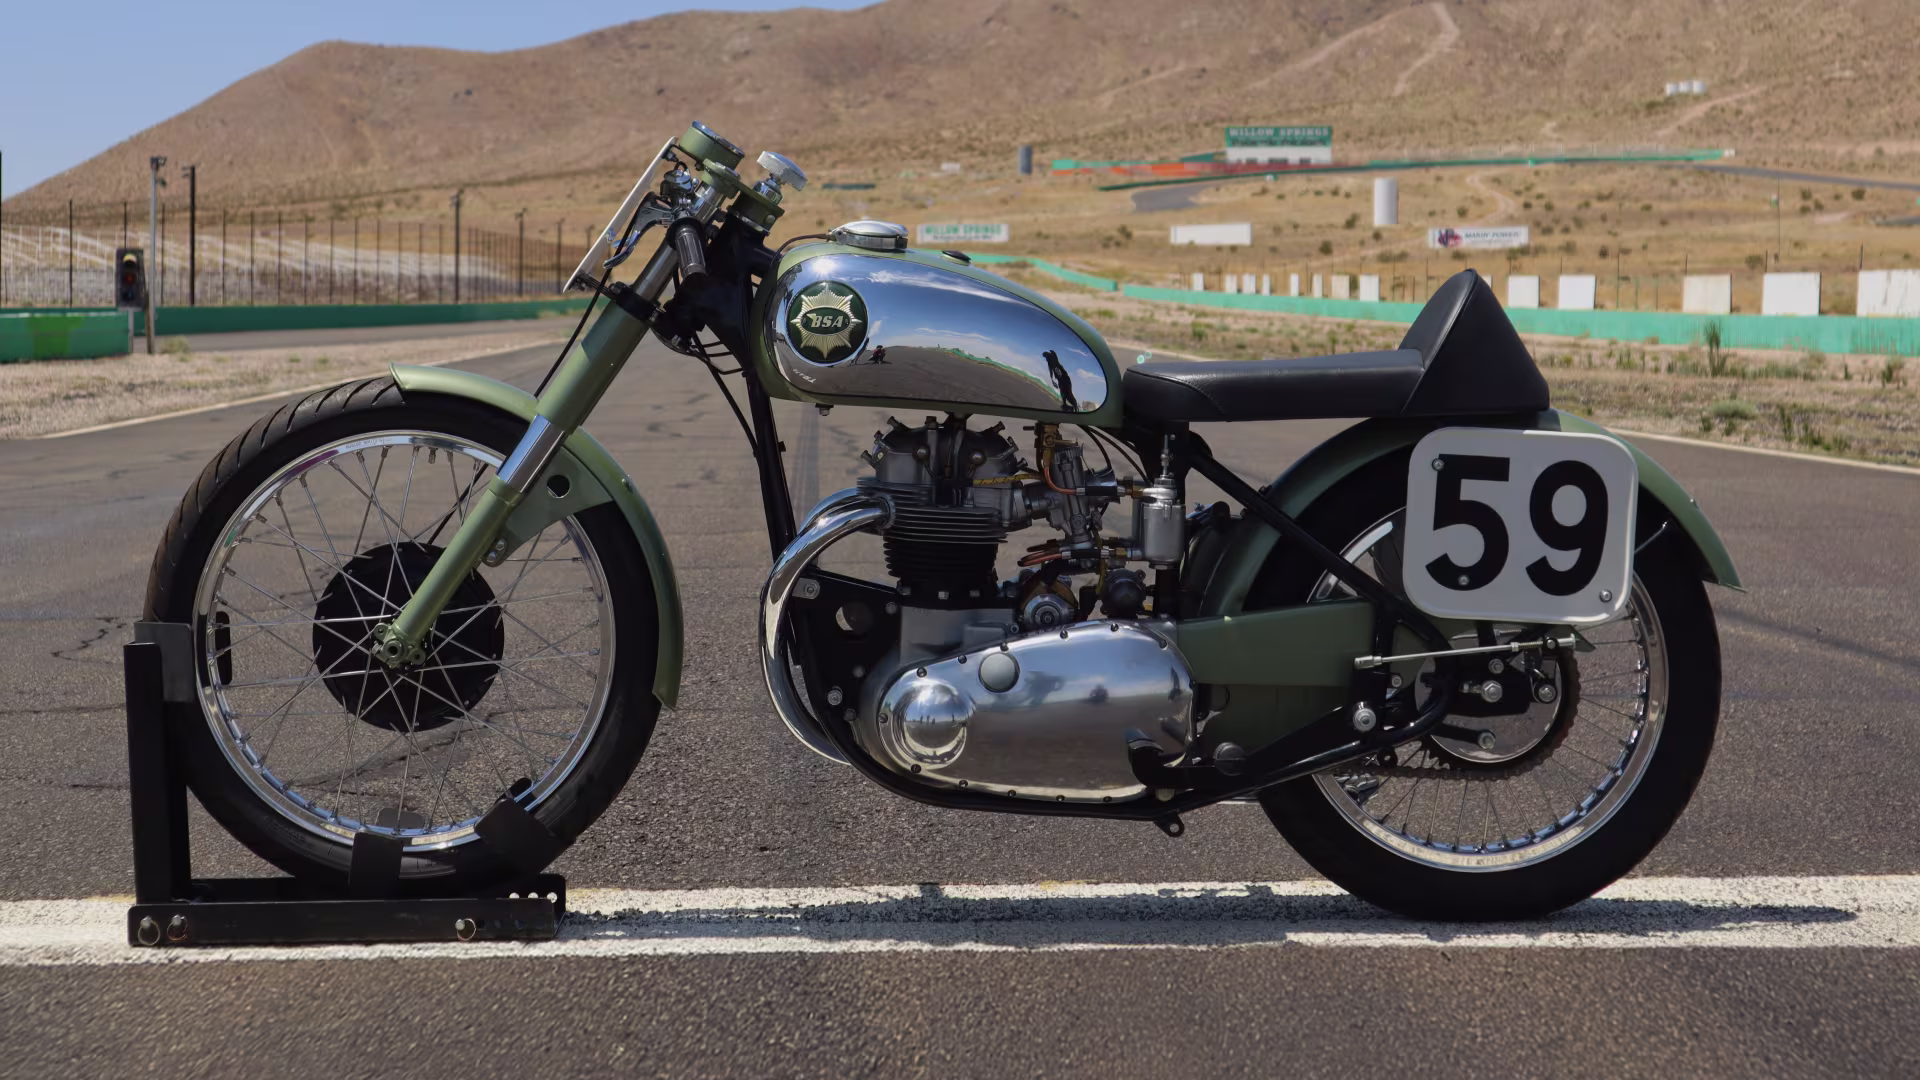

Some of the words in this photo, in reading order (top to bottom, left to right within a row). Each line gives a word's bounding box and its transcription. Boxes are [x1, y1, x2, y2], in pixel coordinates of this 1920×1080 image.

[1229, 127, 1274, 137] WILLOW
[1279, 127, 1329, 137] SPRINGS
[807, 313, 844, 328] BSA
[1425, 453, 1609, 596] 59
